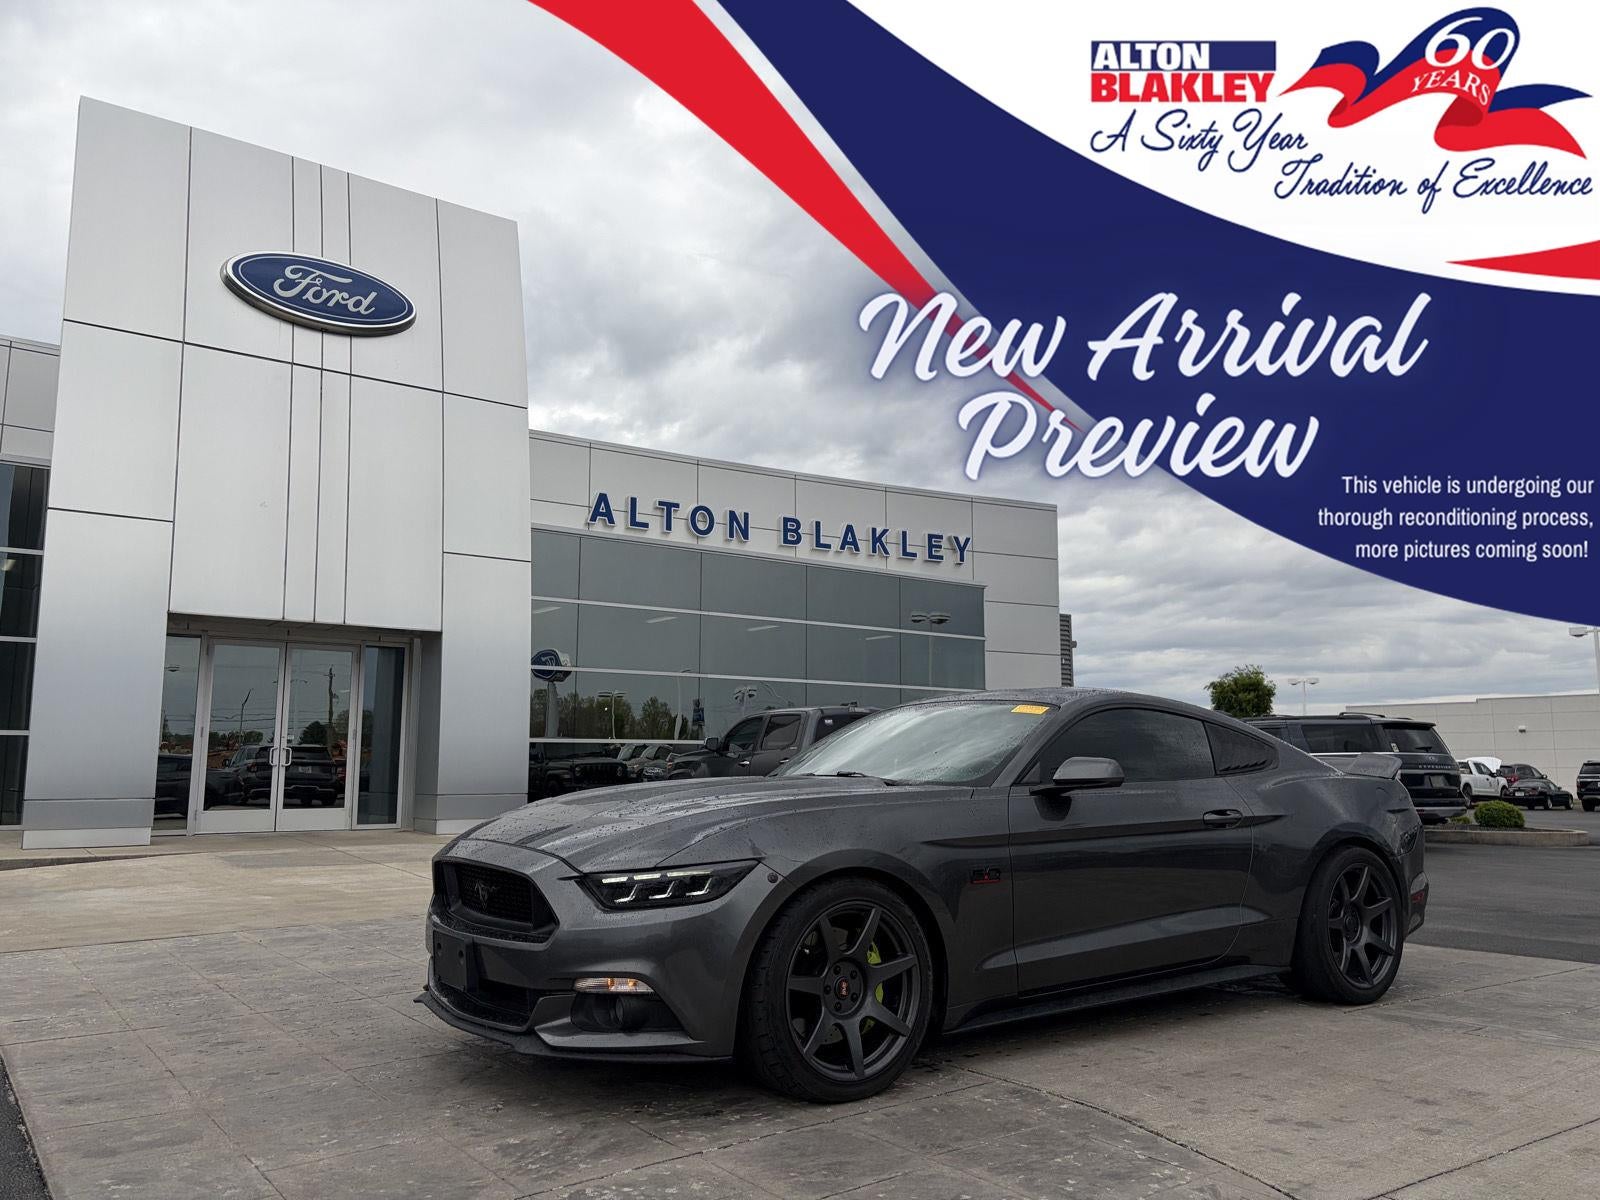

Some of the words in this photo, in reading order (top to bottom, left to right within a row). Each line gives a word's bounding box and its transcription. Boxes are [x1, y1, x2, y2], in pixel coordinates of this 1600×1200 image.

[273, 265, 377, 314] Ford
[588, 492, 751, 543] ALTON
[780, 515, 972, 565] BLAKLEY
